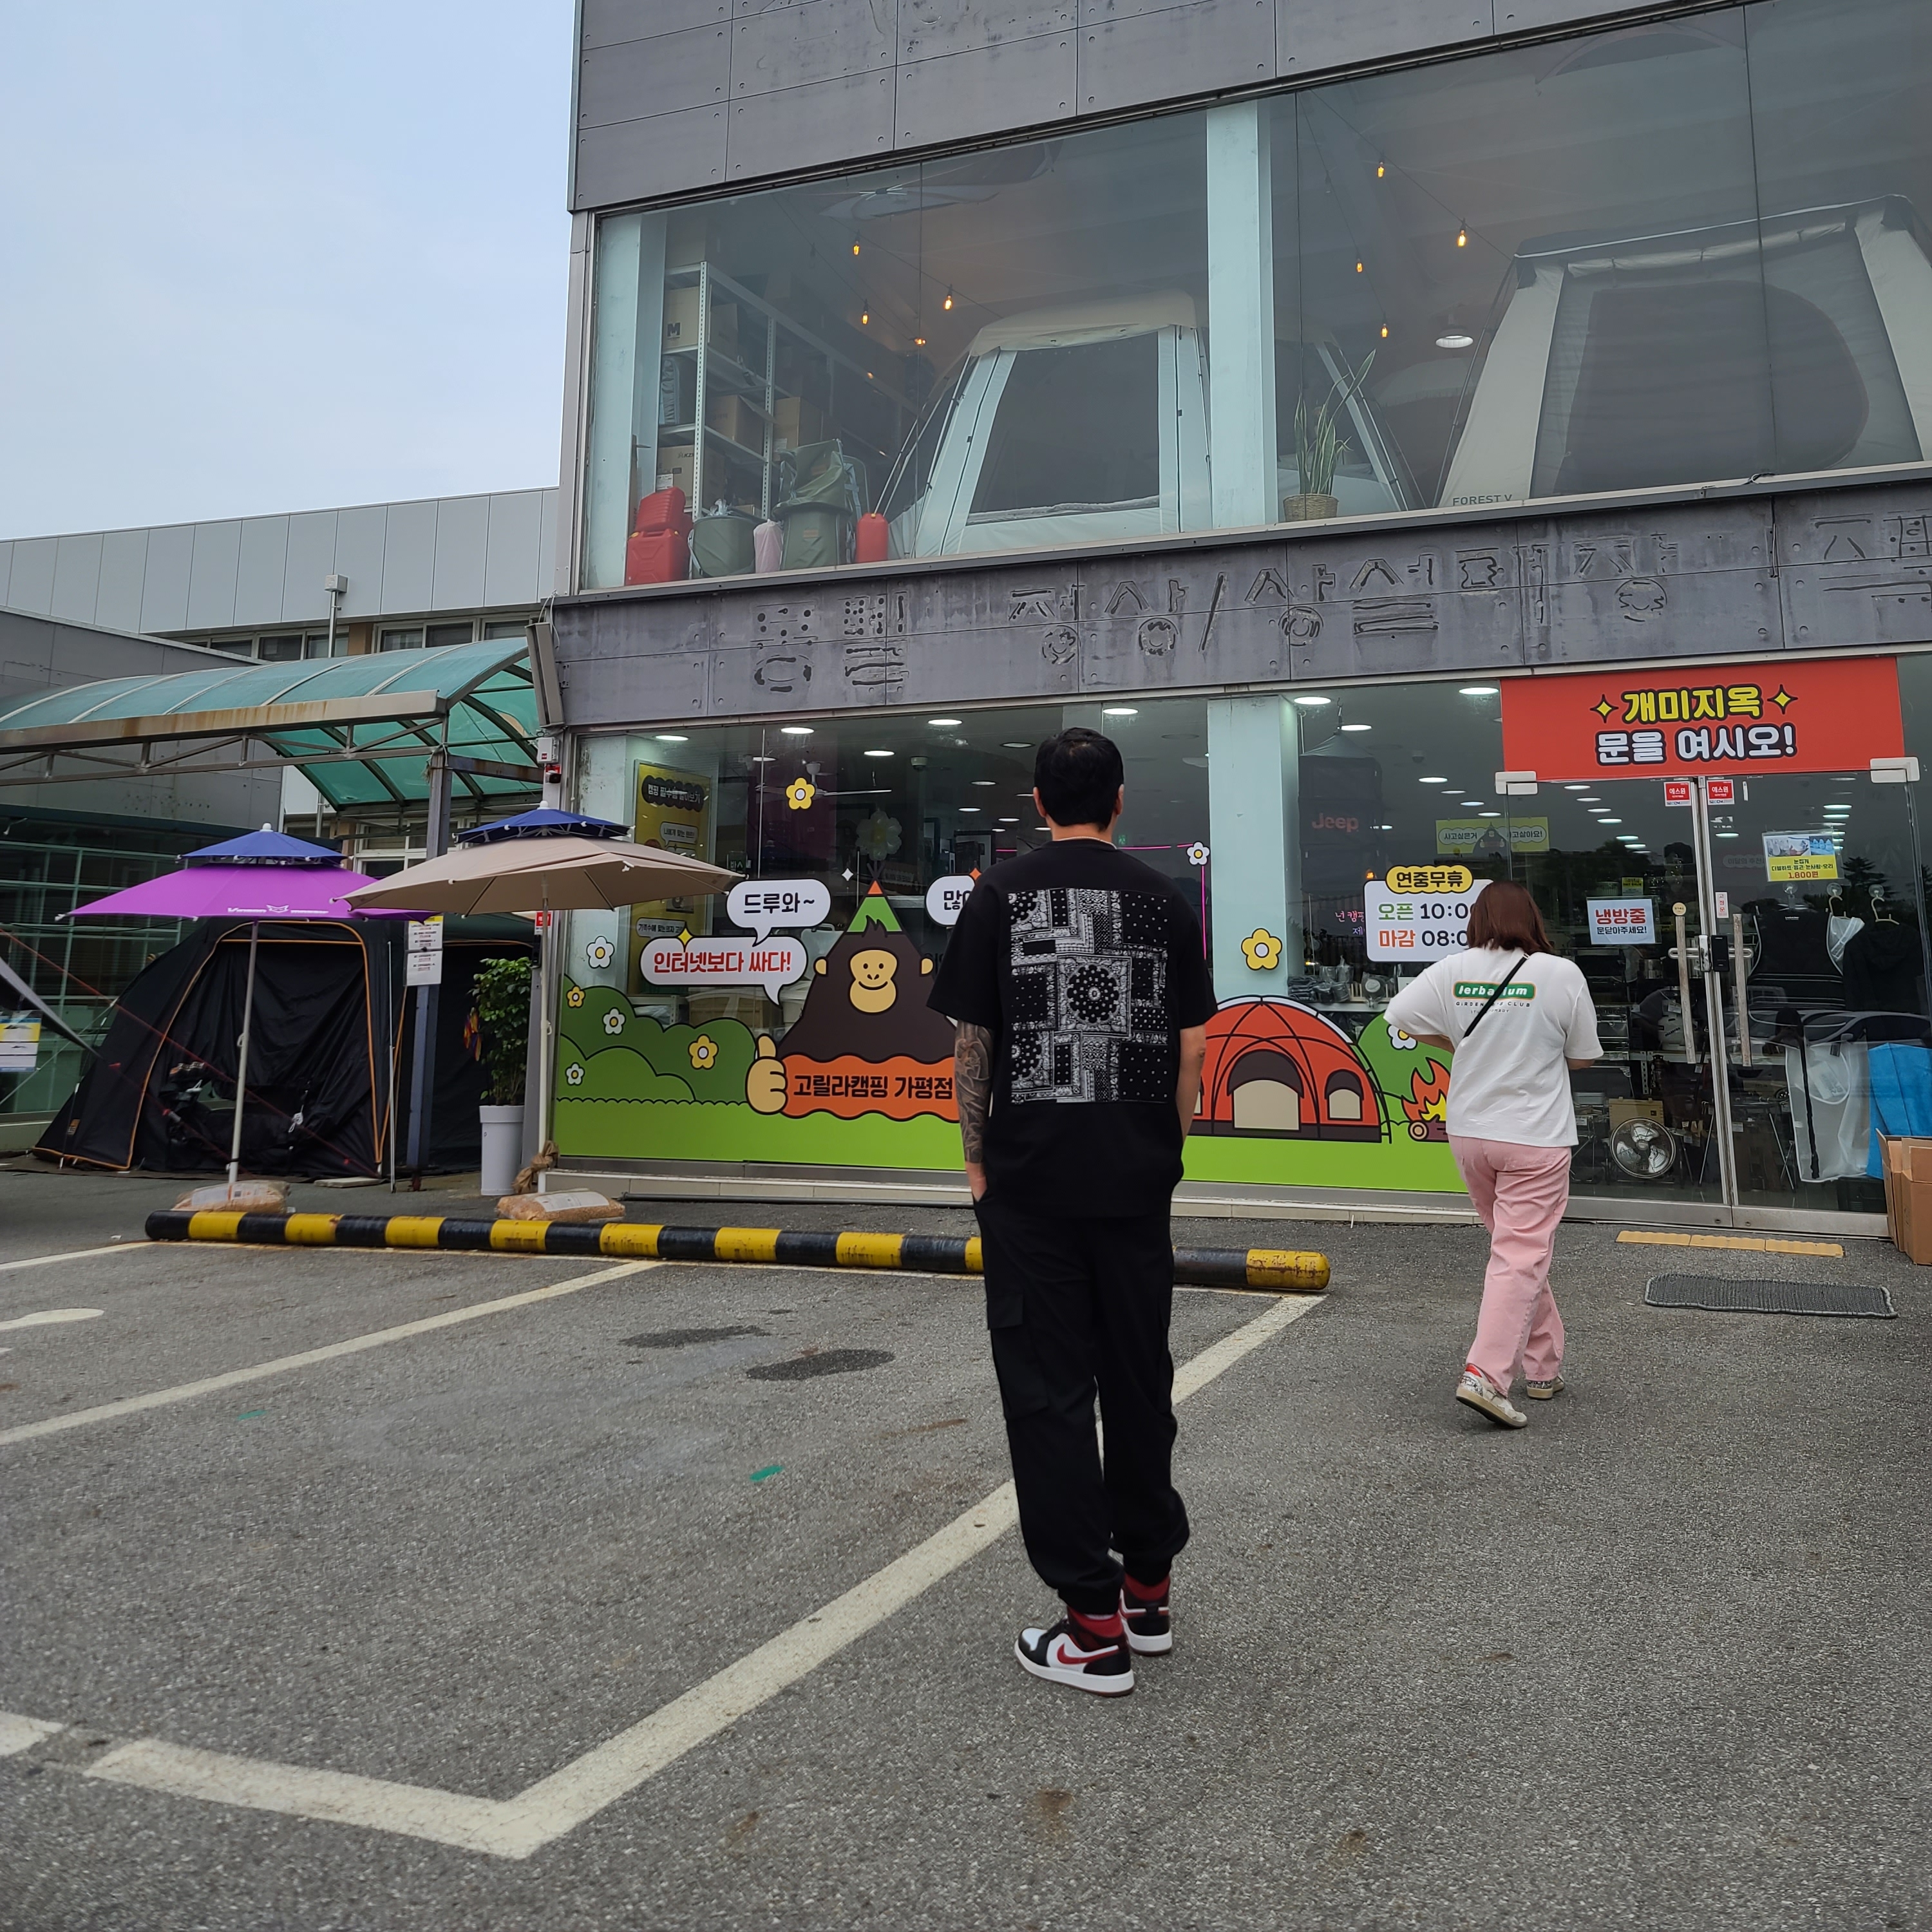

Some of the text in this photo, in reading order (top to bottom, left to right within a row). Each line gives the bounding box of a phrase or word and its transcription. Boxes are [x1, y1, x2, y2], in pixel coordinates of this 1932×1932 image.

[1452, 495, 1502, 506] FOREST
[1622, 685, 1762, 723] 개미지옥
[1597, 724, 1795, 764] 문을 여시오!
[648, 784, 659, 796] 캠핑
[1312, 813, 1359, 832] Jeep
[1444, 831, 1477, 840] 사고싶은거
[1396, 871, 1464, 889] 연중무휴
[744, 892, 815, 914] 드루와~
[1378, 902, 1473, 920] 오픈 10:0
[1334, 911, 1345, 922] 넌
[1595, 907, 1646, 925] 냉방중
[1379, 929, 1416, 948] 마감
[1596, 926, 1647, 935] 문닫아주세요!
[654, 951, 791, 974] 인터넷보다 싸다!
[793, 1074, 953, 1100] 고릴라캠핑 가평점
